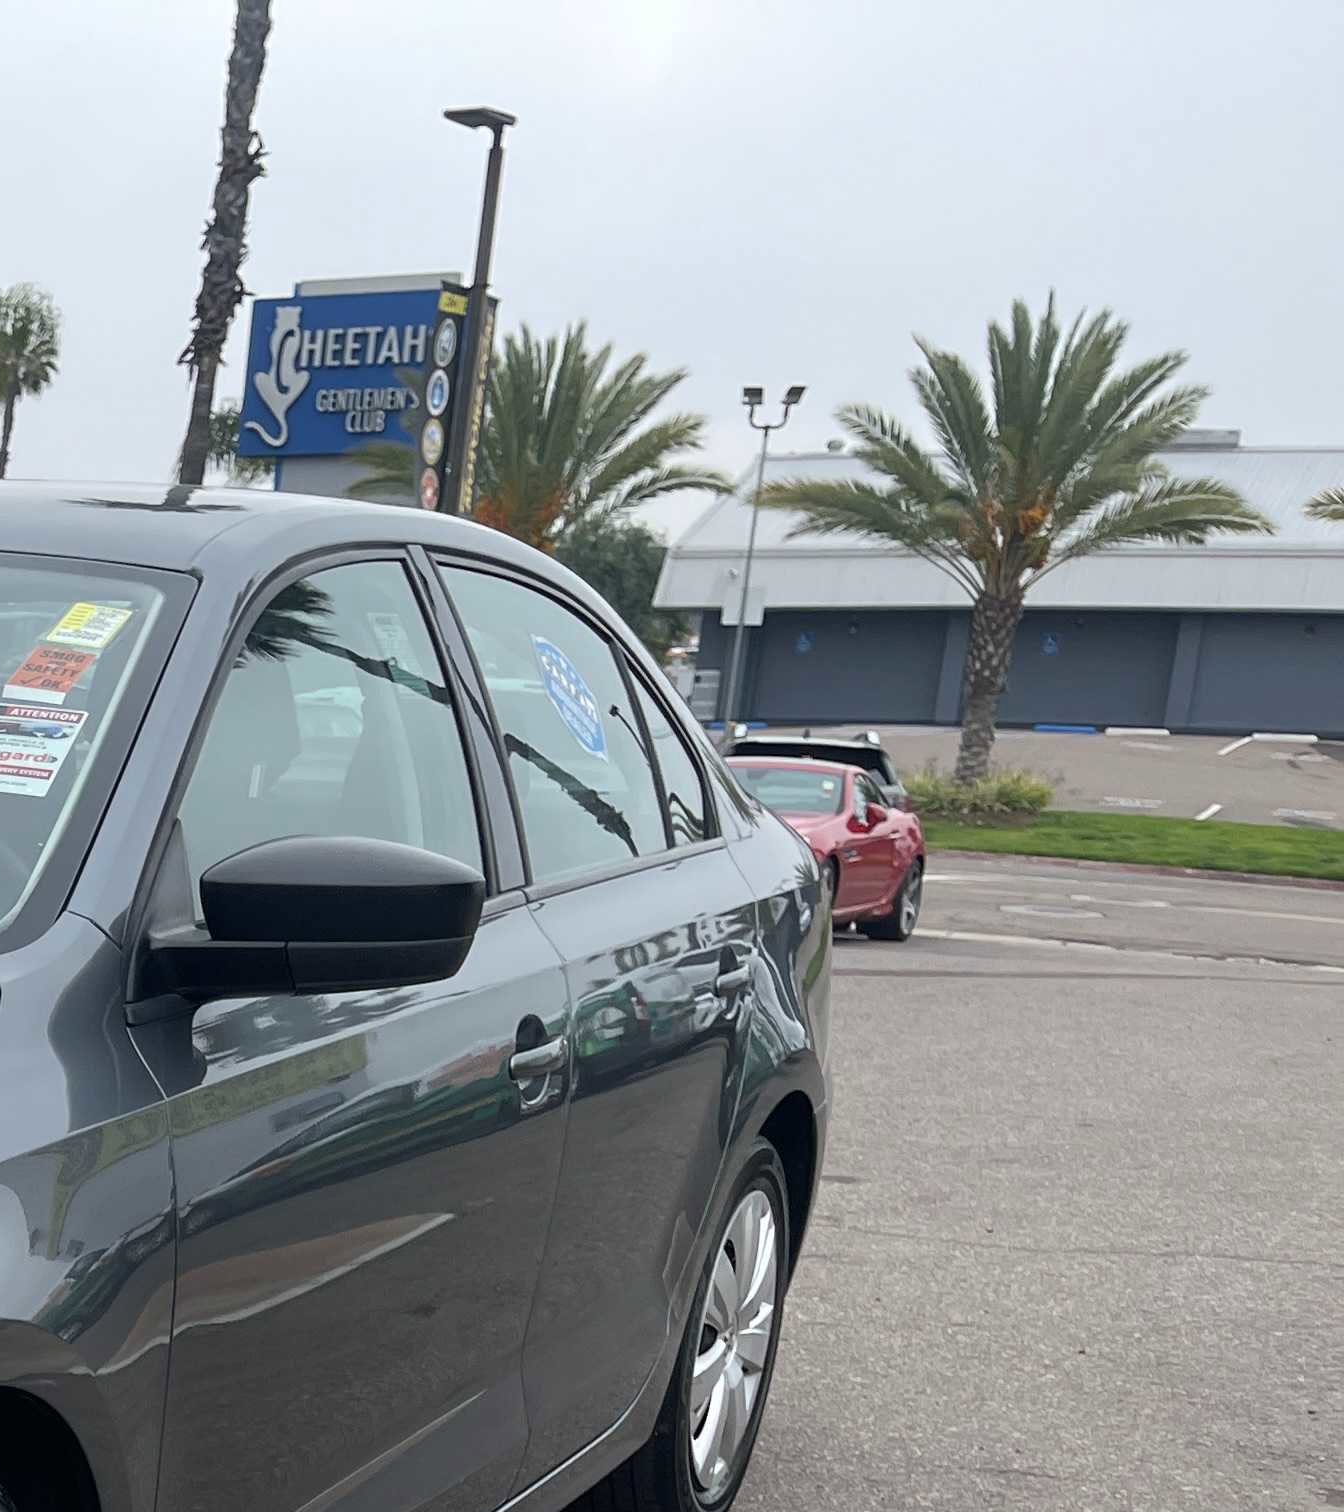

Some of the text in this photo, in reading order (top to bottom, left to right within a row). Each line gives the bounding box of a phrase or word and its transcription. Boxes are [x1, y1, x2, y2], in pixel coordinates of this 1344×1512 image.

[316, 386, 421, 412] GENTLEMEN'S
[344, 411, 386, 433] CLUB
[22, 663, 81, 678] SAFETY
[39, 678, 60, 689] OK
[10, 706, 80, 722] ATTENTION
